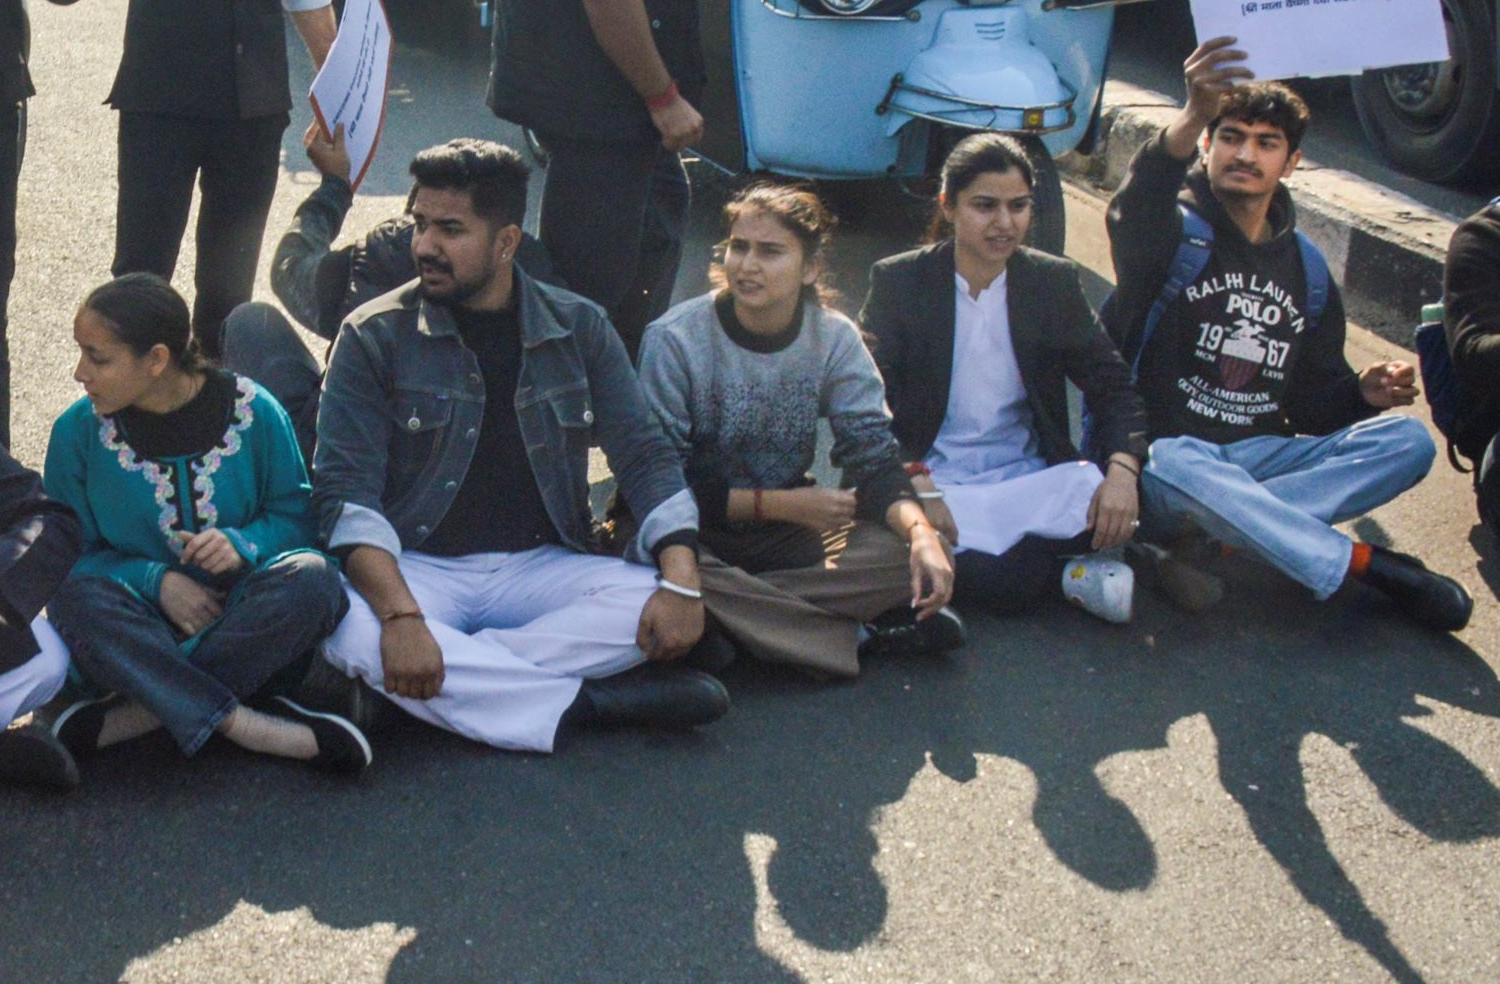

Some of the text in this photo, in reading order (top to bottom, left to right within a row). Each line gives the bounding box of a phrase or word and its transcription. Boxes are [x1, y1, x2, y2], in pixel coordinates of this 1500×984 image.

[1226, 294, 1281, 325] POLO
[1197, 322, 1291, 368] 19 67
[1190, 375, 1270, 403] ALL-AMERICAN
[1186, 398, 1254, 426] NEW YORK
[1246, 402, 1279, 414] GOODS
